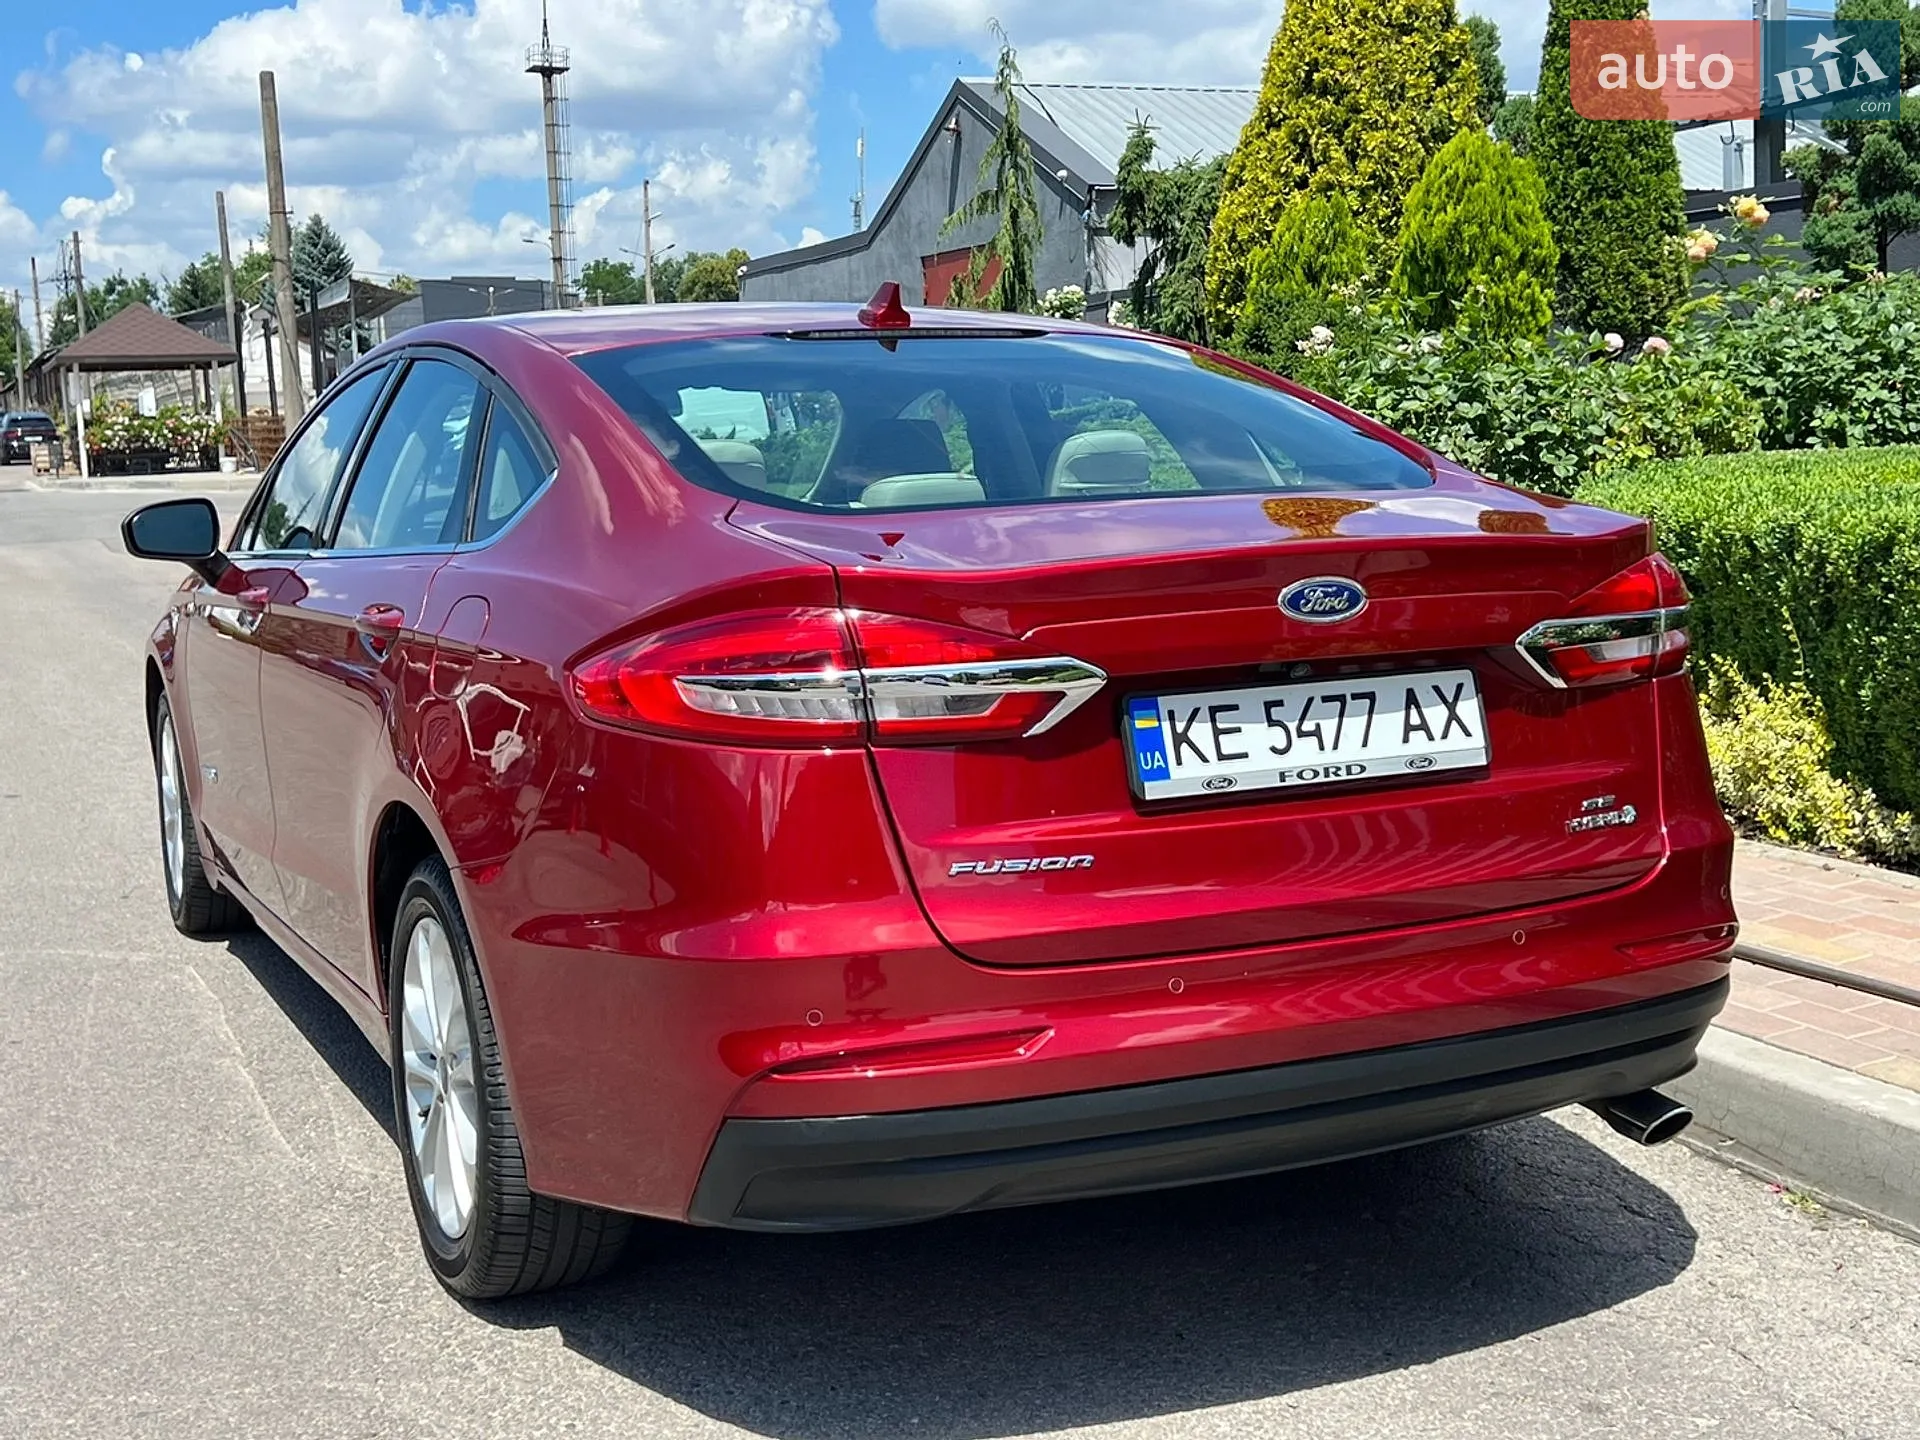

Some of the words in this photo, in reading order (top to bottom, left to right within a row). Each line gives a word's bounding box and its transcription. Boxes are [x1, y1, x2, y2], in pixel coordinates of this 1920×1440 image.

[1300, 586, 1350, 612] Ford
[1167, 703, 1249, 766] KE
[1264, 691, 1377, 755] 5477
[1402, 682, 1473, 744] AX
[1140, 751, 1166, 770] UA
[1278, 763, 1367, 783] FORD
[949, 854, 1095, 876] FUSION
